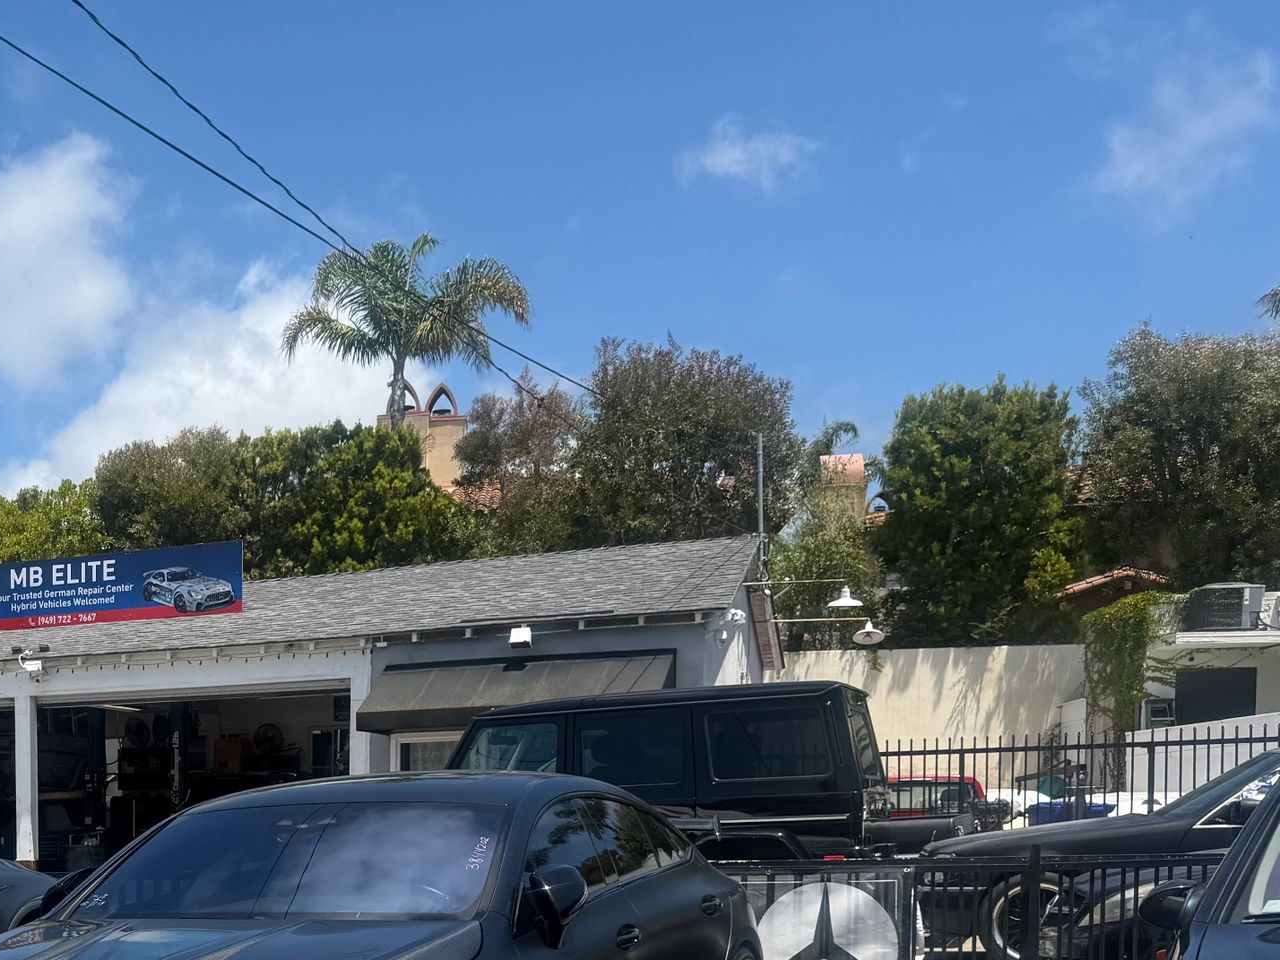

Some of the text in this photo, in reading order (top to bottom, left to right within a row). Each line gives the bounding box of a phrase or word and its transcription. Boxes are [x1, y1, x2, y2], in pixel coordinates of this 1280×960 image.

[10, 560, 116, 589] MB ELITE
[12, 591, 42, 601] Trusted
[44, 588, 76, 598] German
[78, 585, 104, 597] Repair
[106, 584, 134, 593] Center
[11, 595, 115, 613] Hybrid Vehicles Welcomed
[38, 616, 56, 626] (949)
[58, 615, 72, 624] 722
[78, 613, 97, 622] 7667
